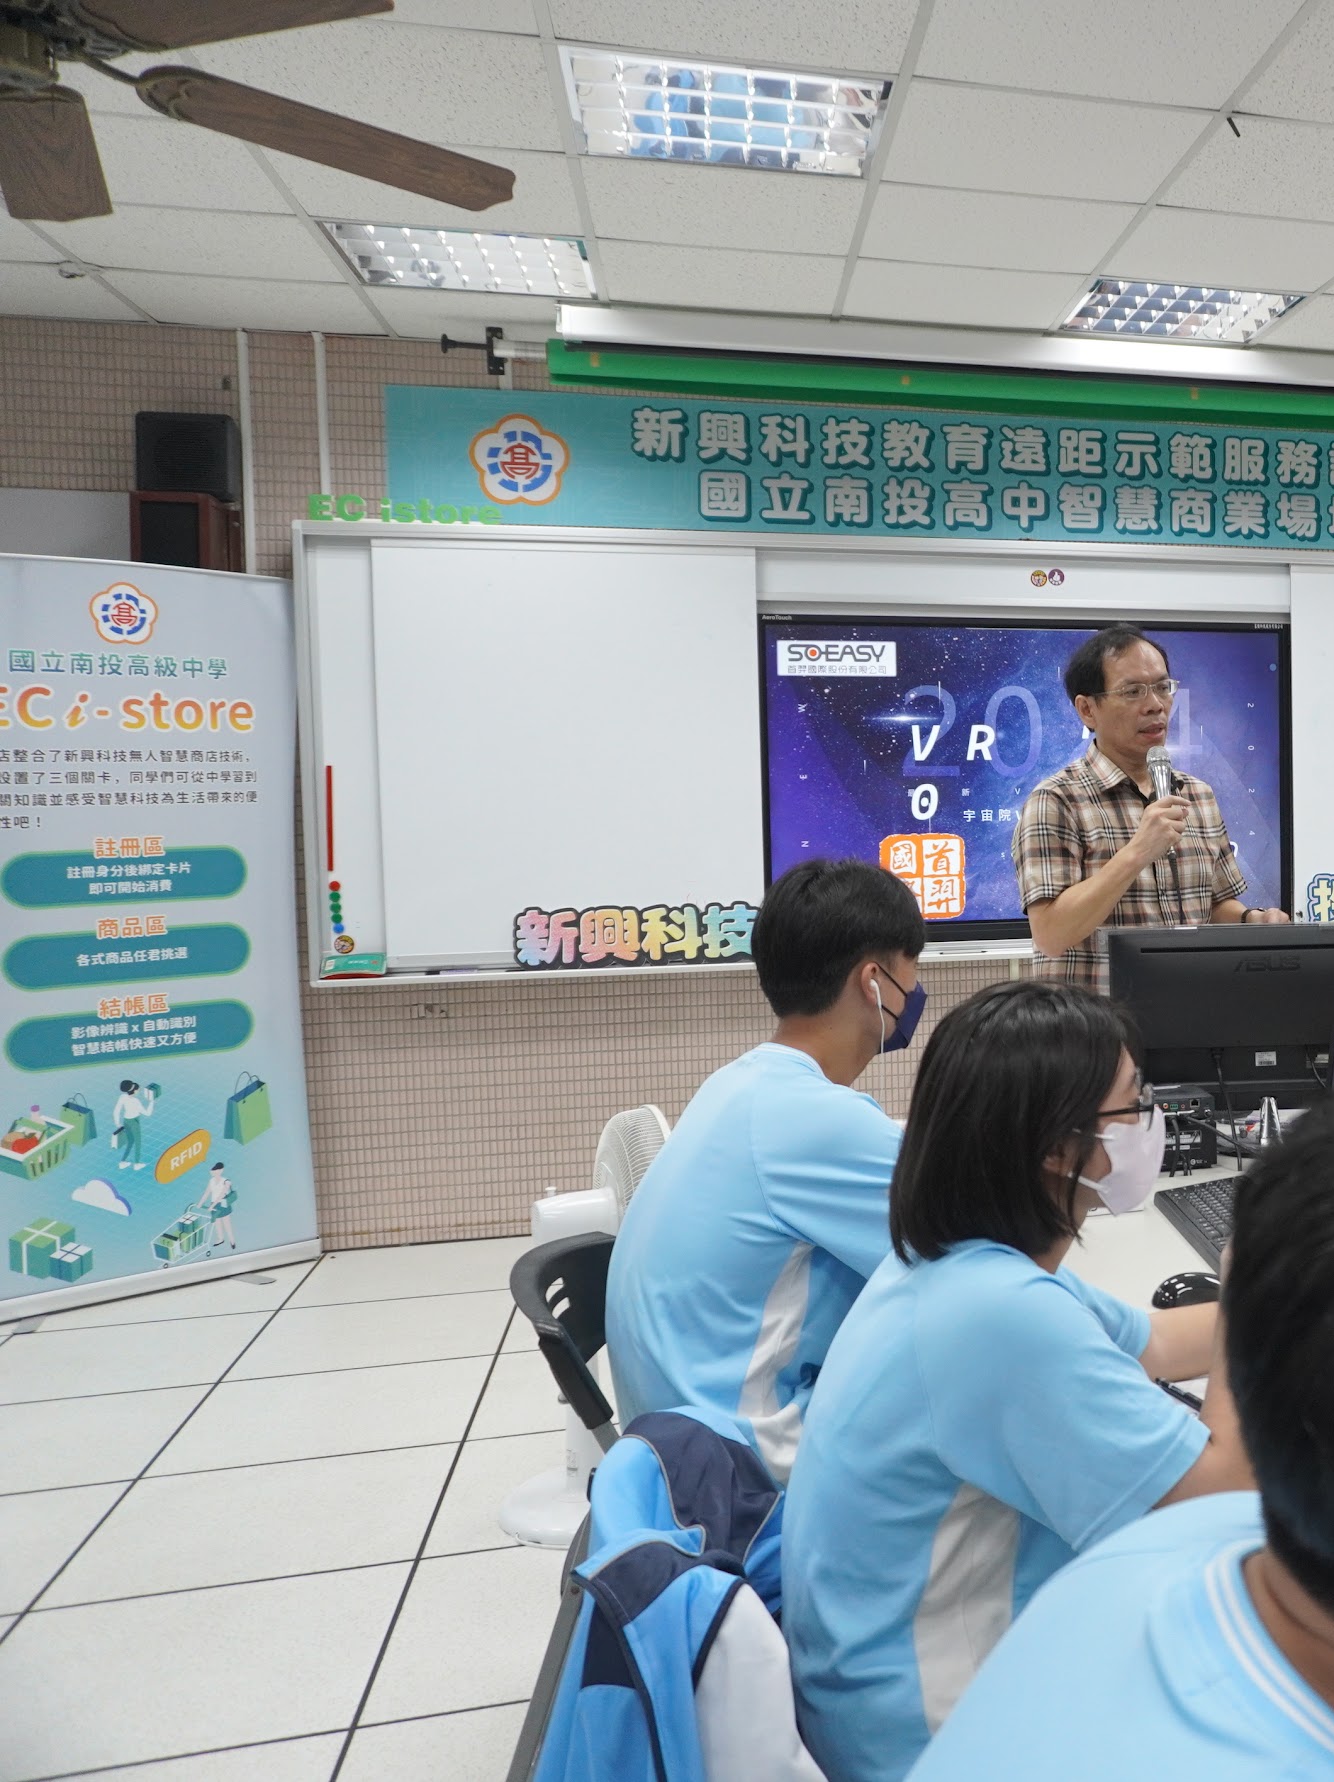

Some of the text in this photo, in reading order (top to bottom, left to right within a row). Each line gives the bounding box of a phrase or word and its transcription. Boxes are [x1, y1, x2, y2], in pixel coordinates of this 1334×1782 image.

[308, 495, 502, 526] EC istore
[9, 650, 228, 680] 國立南投高級中學
[95, 837, 164, 857] 註冊區
[66, 863, 191, 878] 註冊身分後綁定卡片
[89, 880, 172, 895] 即可開始消費
[97, 914, 168, 939] 商品區
[514, 902, 760, 968] 新興科技
[76, 947, 188, 967] 各式商品任君挑選
[99, 994, 169, 1018] 結帳區
[71, 1021, 128, 1040] 影像辨識
[142, 1016, 197, 1032] 自動識別
[71, 1032, 198, 1056] 智慧結帳快速又方便
[169, 1141, 203, 1172] RFID
